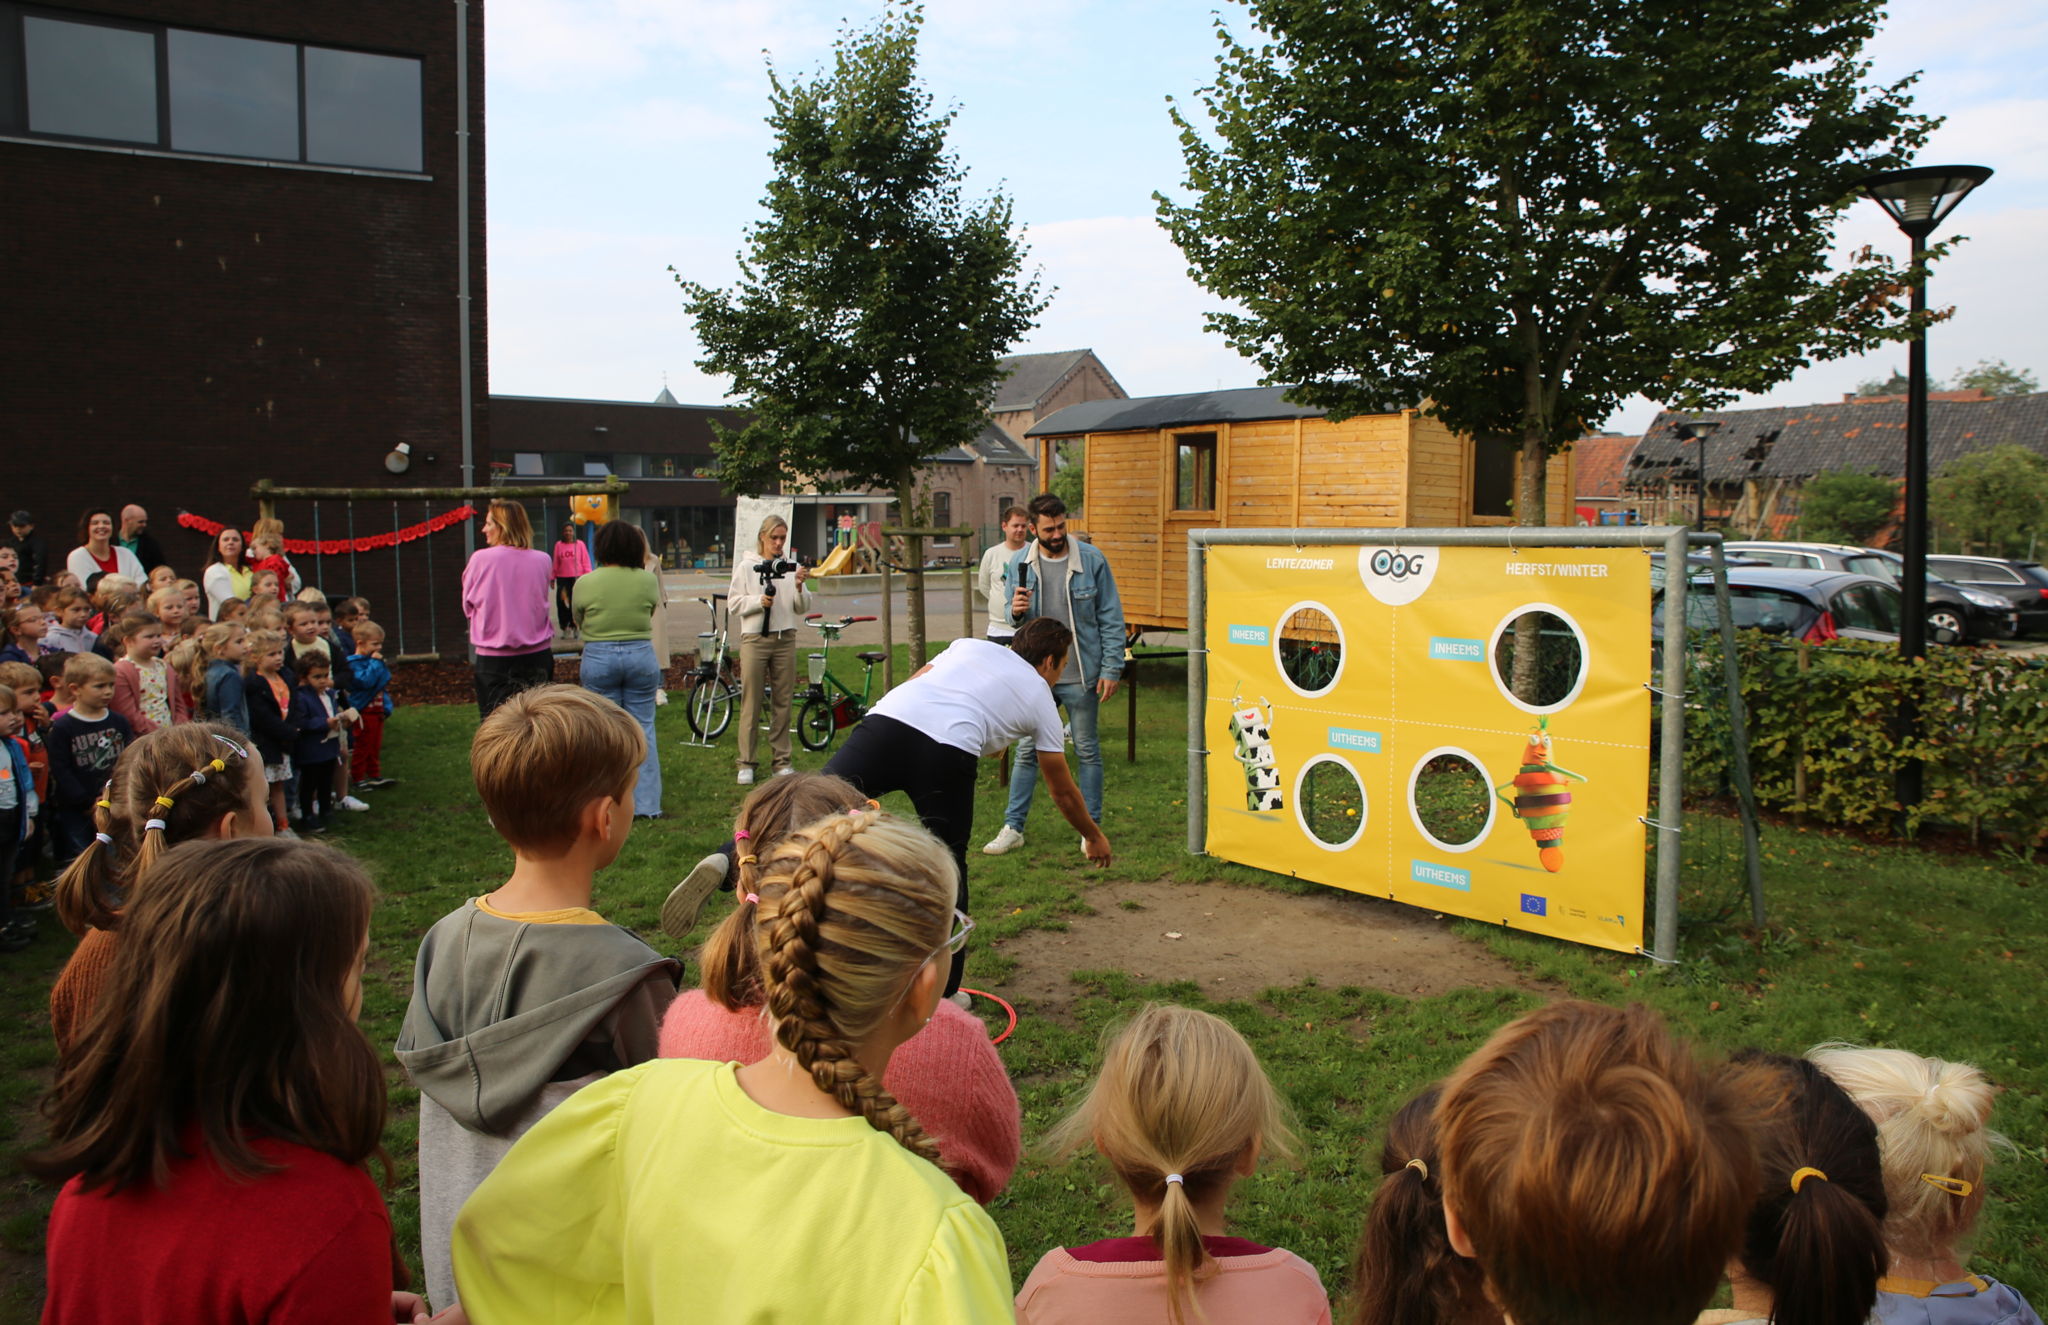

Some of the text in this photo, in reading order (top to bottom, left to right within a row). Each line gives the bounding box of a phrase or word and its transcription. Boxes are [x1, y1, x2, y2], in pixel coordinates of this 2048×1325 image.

[1265, 558, 1335, 571] LENTE/ZOMER
[1370, 549, 1425, 578] OOG
[1505, 562, 1608, 578] HERFST/WINTER
[1232, 629, 1266, 641] INHEEMS
[1434, 642, 1480, 657] INHEEMS
[1331, 731, 1377, 748] UITHEEMS
[1415, 864, 1467, 886] UITHEEMS
